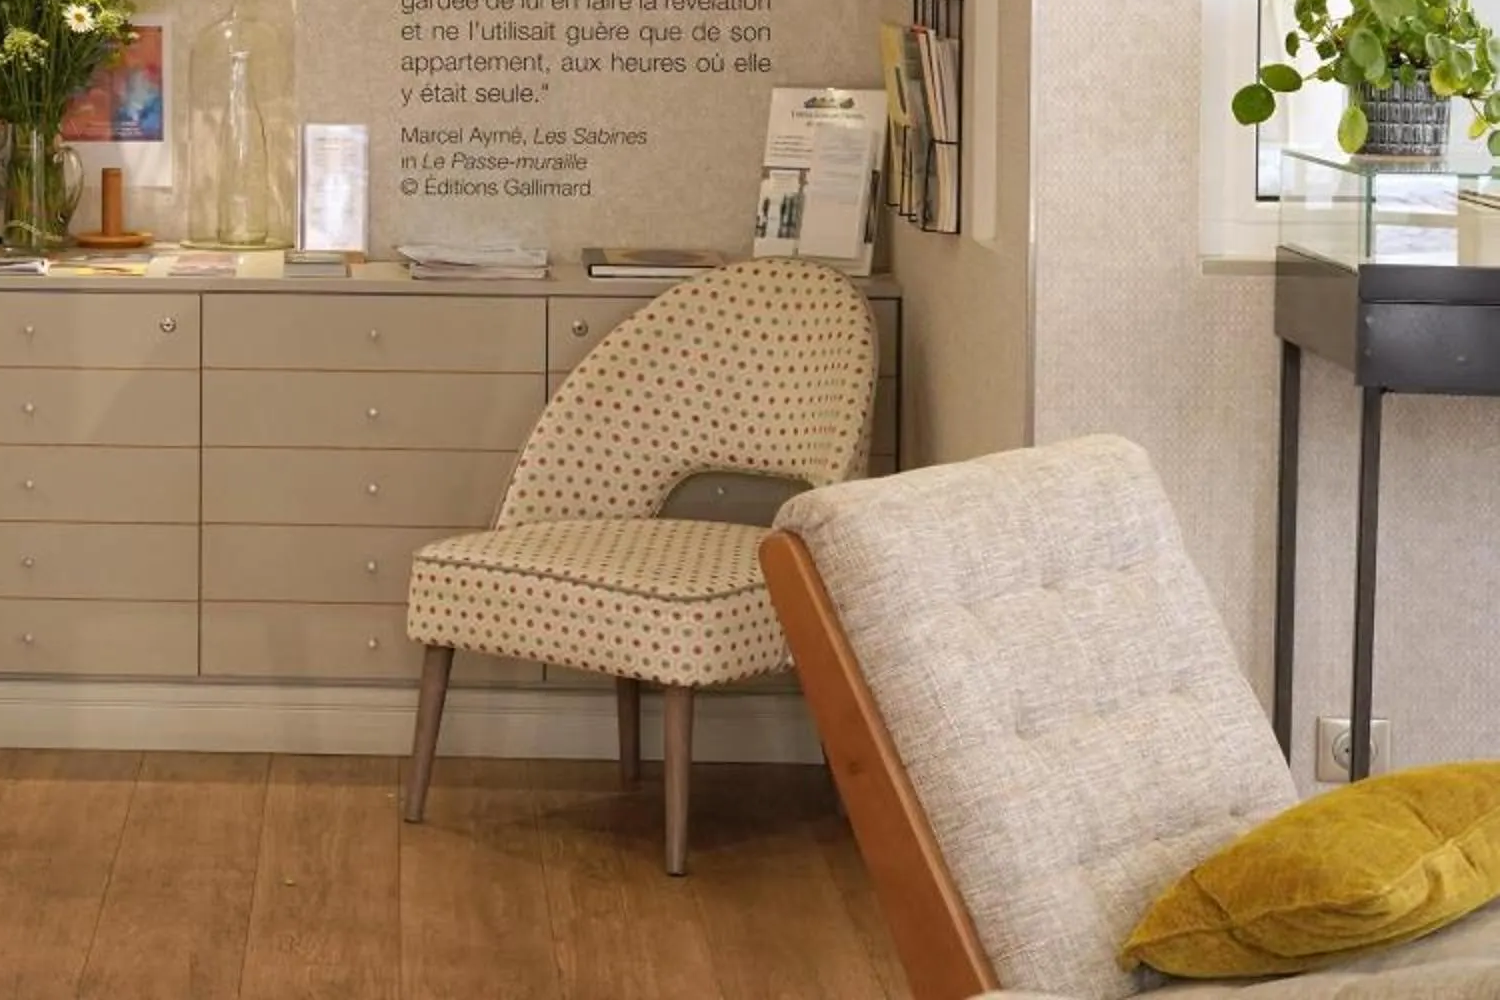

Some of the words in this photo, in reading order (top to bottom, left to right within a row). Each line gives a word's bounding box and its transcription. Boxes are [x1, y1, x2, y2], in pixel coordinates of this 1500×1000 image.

[400, 23, 422, 41] et
[432, 25, 460, 41] ne
[469, 20, 556, 41] l'utilisait
[565, 21, 630, 47] guère
[639, 25, 682, 46] que
[691, 24, 721, 43] de
[730, 25, 771, 43] son
[400, 53, 551, 76] appartement,
[560, 55, 602, 73] aux
[610, 52, 687, 73] heures
[695, 52, 725, 74] où
[733, 52, 772, 74] elle
[400, 87, 413, 108] y
[419, 84, 467, 104] était
[475, 83, 549, 104] seule."
[400, 126, 463, 145] Marcel
[469, 126, 527, 148] Aymé,
[533, 127, 567, 145] Les
[572, 127, 648, 146] Sabines
[401, 152, 417, 171] in
[422, 152, 447, 171] Le
[451, 151, 588, 171] Passe-muraille
[400, 177, 419, 197] ©
[424, 176, 499, 197] Éditions
[503, 178, 592, 197] Gallimard
